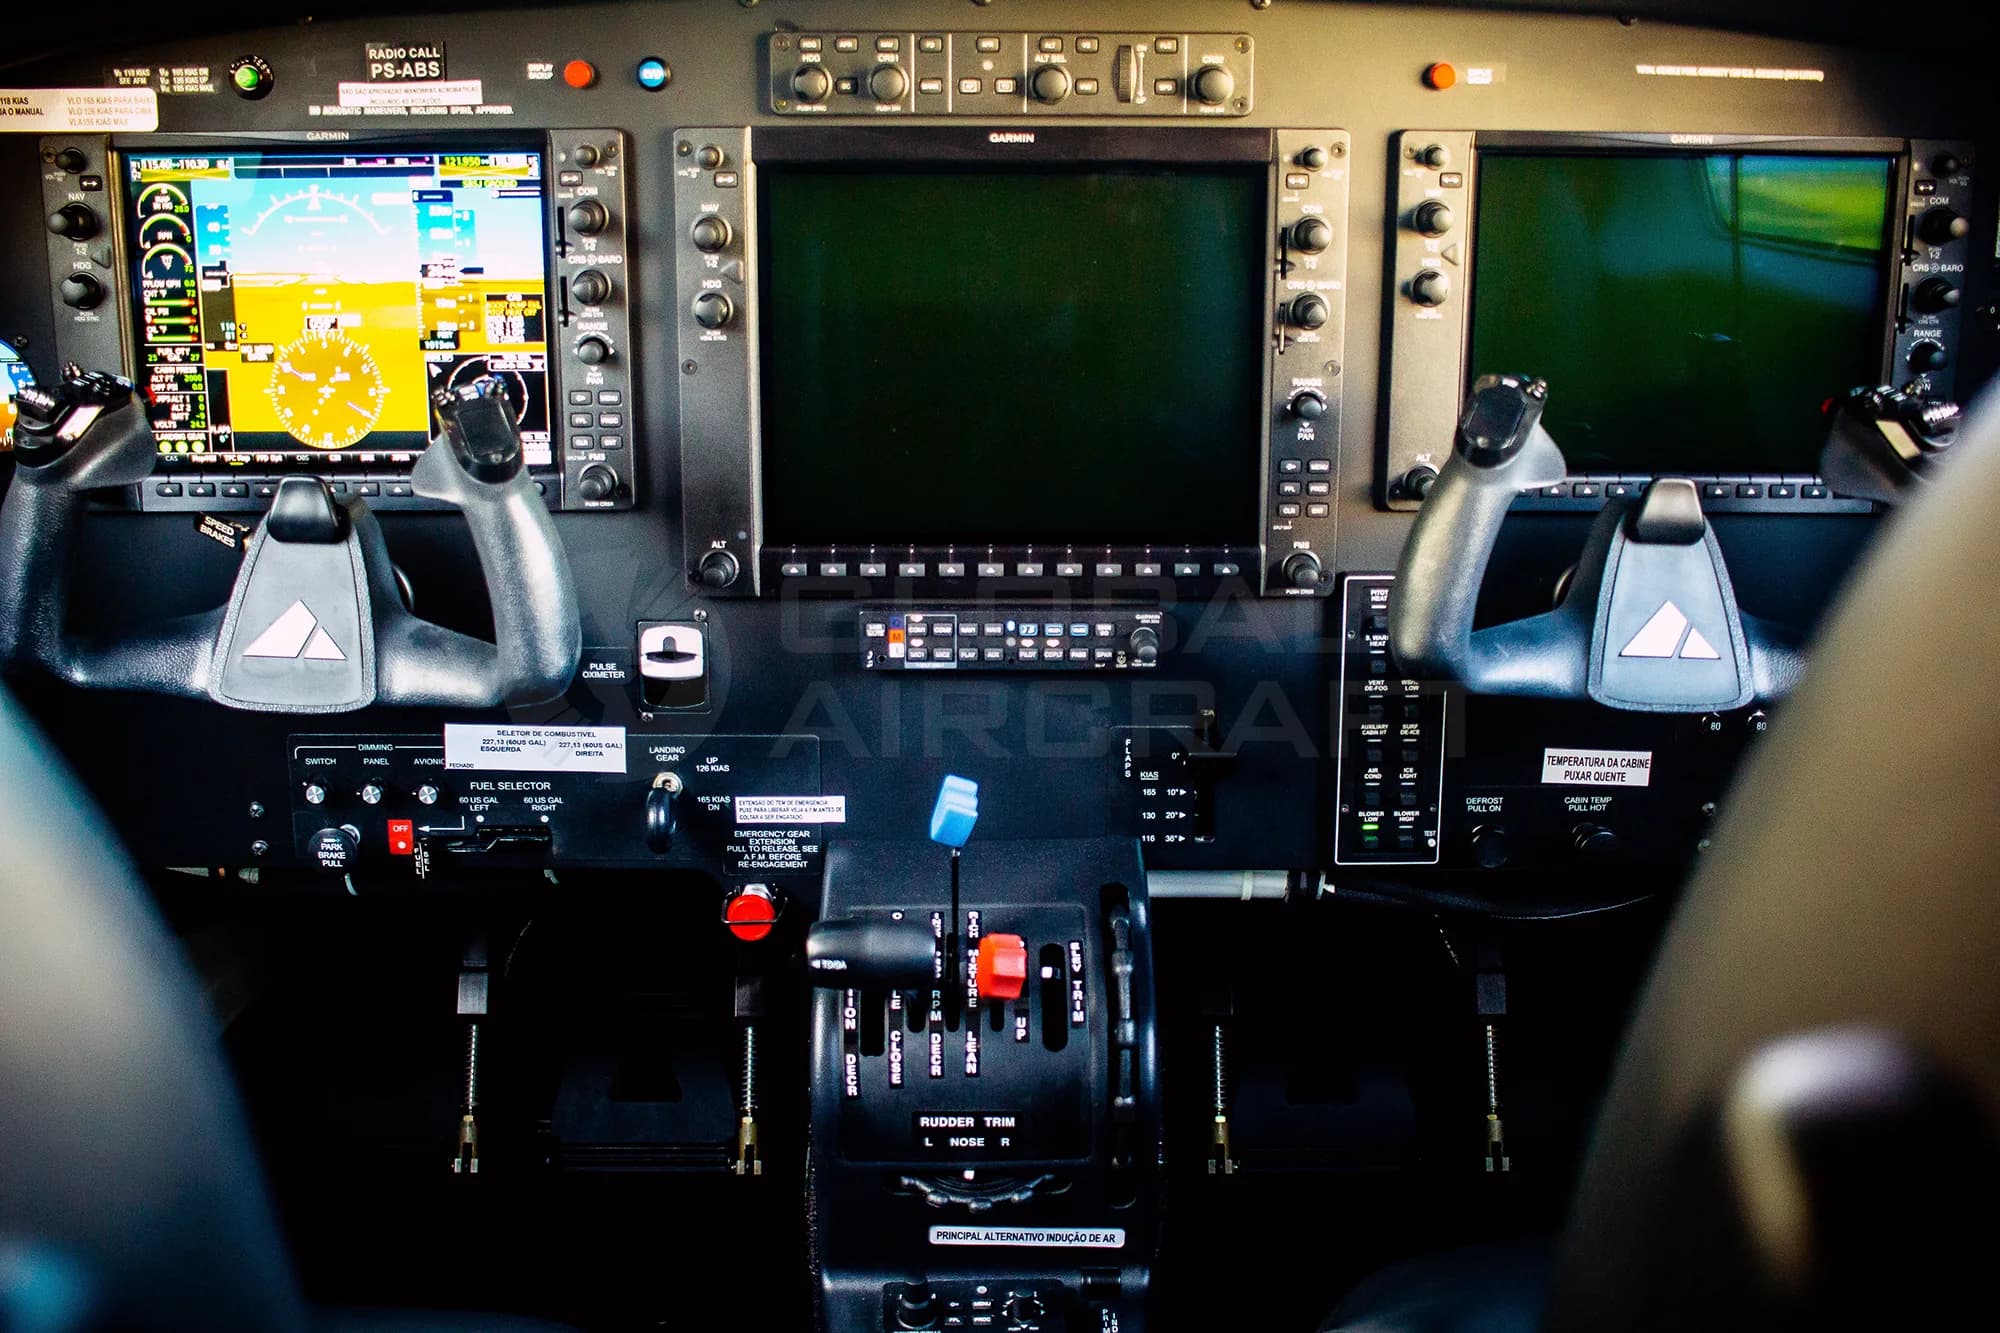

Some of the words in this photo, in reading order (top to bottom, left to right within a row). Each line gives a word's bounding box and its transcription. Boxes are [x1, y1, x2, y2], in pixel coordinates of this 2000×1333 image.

[369, 48, 404, 60] RADIO
[409, 47, 441, 59] CALL
[370, 62, 440, 79] PS-ABS
[12, 97, 29, 105] KIAS
[8, 108, 14, 116] O
[15, 108, 44, 116] MANUAL
[322, 106, 362, 115] ACROBATIC
[364, 106, 409, 116] MANEUVERS,
[410, 106, 448, 115] INCLUDING
[450, 106, 474, 116] SPINS,
[476, 106, 514, 115] APPROVED.
[306, 132, 350, 141] GARMIN
[989, 132, 1034, 143] GARMIN
[1671, 135, 1713, 144] GARMIN
[576, 187, 598, 196] COM
[1929, 197, 1949, 205] COM
[701, 204, 719, 212] NAV
[73, 262, 92, 270] HDG
[702, 280, 722, 288] HDG
[577, 322, 608, 331] RANGE
[1297, 432, 1314, 441] PAN
[165, 454, 178, 462] CAS
[1310, 463, 1328, 471] MENU
[204, 516, 234, 536] SPEED
[200, 524, 236, 547] BRAKES
[1293, 541, 1310, 549] FMS
[649, 746, 686, 754] LANDING
[305, 758, 337, 766] SWITCH
[656, 754, 680, 762] GEAR
[1547, 756, 1606, 768] TEMPERATURA
[1608, 757, 1619, 768] DA
[1620, 758, 1650, 769] CABINE
[1564, 770, 1592, 782] PUXAR
[1594, 771, 1626, 782] QUENTE
[470, 782, 496, 790] FUEL
[497, 782, 552, 790] SELECTOR
[1142, 788, 1156, 796] 165
[697, 796, 711, 804] 165
[712, 796, 731, 804] KIAS
[1564, 796, 1588, 804] CABIN
[1590, 796, 1612, 804] TEMP
[470, 804, 489, 812] LEFT
[531, 804, 556, 812] RIGHT
[1588, 804, 1607, 812] HOT
[1142, 812, 1156, 820] 130
[734, 830, 786, 838] EMERGENCY
[786, 830, 810, 838] GEAR
[414, 848, 422, 874] FUEL
[968, 911, 979, 938] RICH
[1070, 942, 1082, 972] ELEV
[968, 949, 980, 1008] MIXTURE
[930, 990, 942, 1021] RPM
[1072, 980, 1084, 1022] TRIM
[1016, 1017, 1026, 1040] UP
[931, 1033, 942, 1076] DECR
[966, 1030, 977, 1074] LEAN
[890, 1030, 902, 1084] CLOSE
[846, 1054, 858, 1096] DECR
[920, 1117, 974, 1128] RUDDER
[984, 1117, 1016, 1128] TRIM
[924, 1138, 933, 1146] L
[950, 1138, 985, 1147] NOSE
[1001, 1138, 1010, 1146] R
[936, 1231, 982, 1240] PRINCIPAL
[984, 1232, 1044, 1242] ALTERNATIVO
[1046, 1232, 1087, 1244] INDUÇÃO
[1088, 1234, 1101, 1242] DE
[1102, 1234, 1116, 1243] AR
